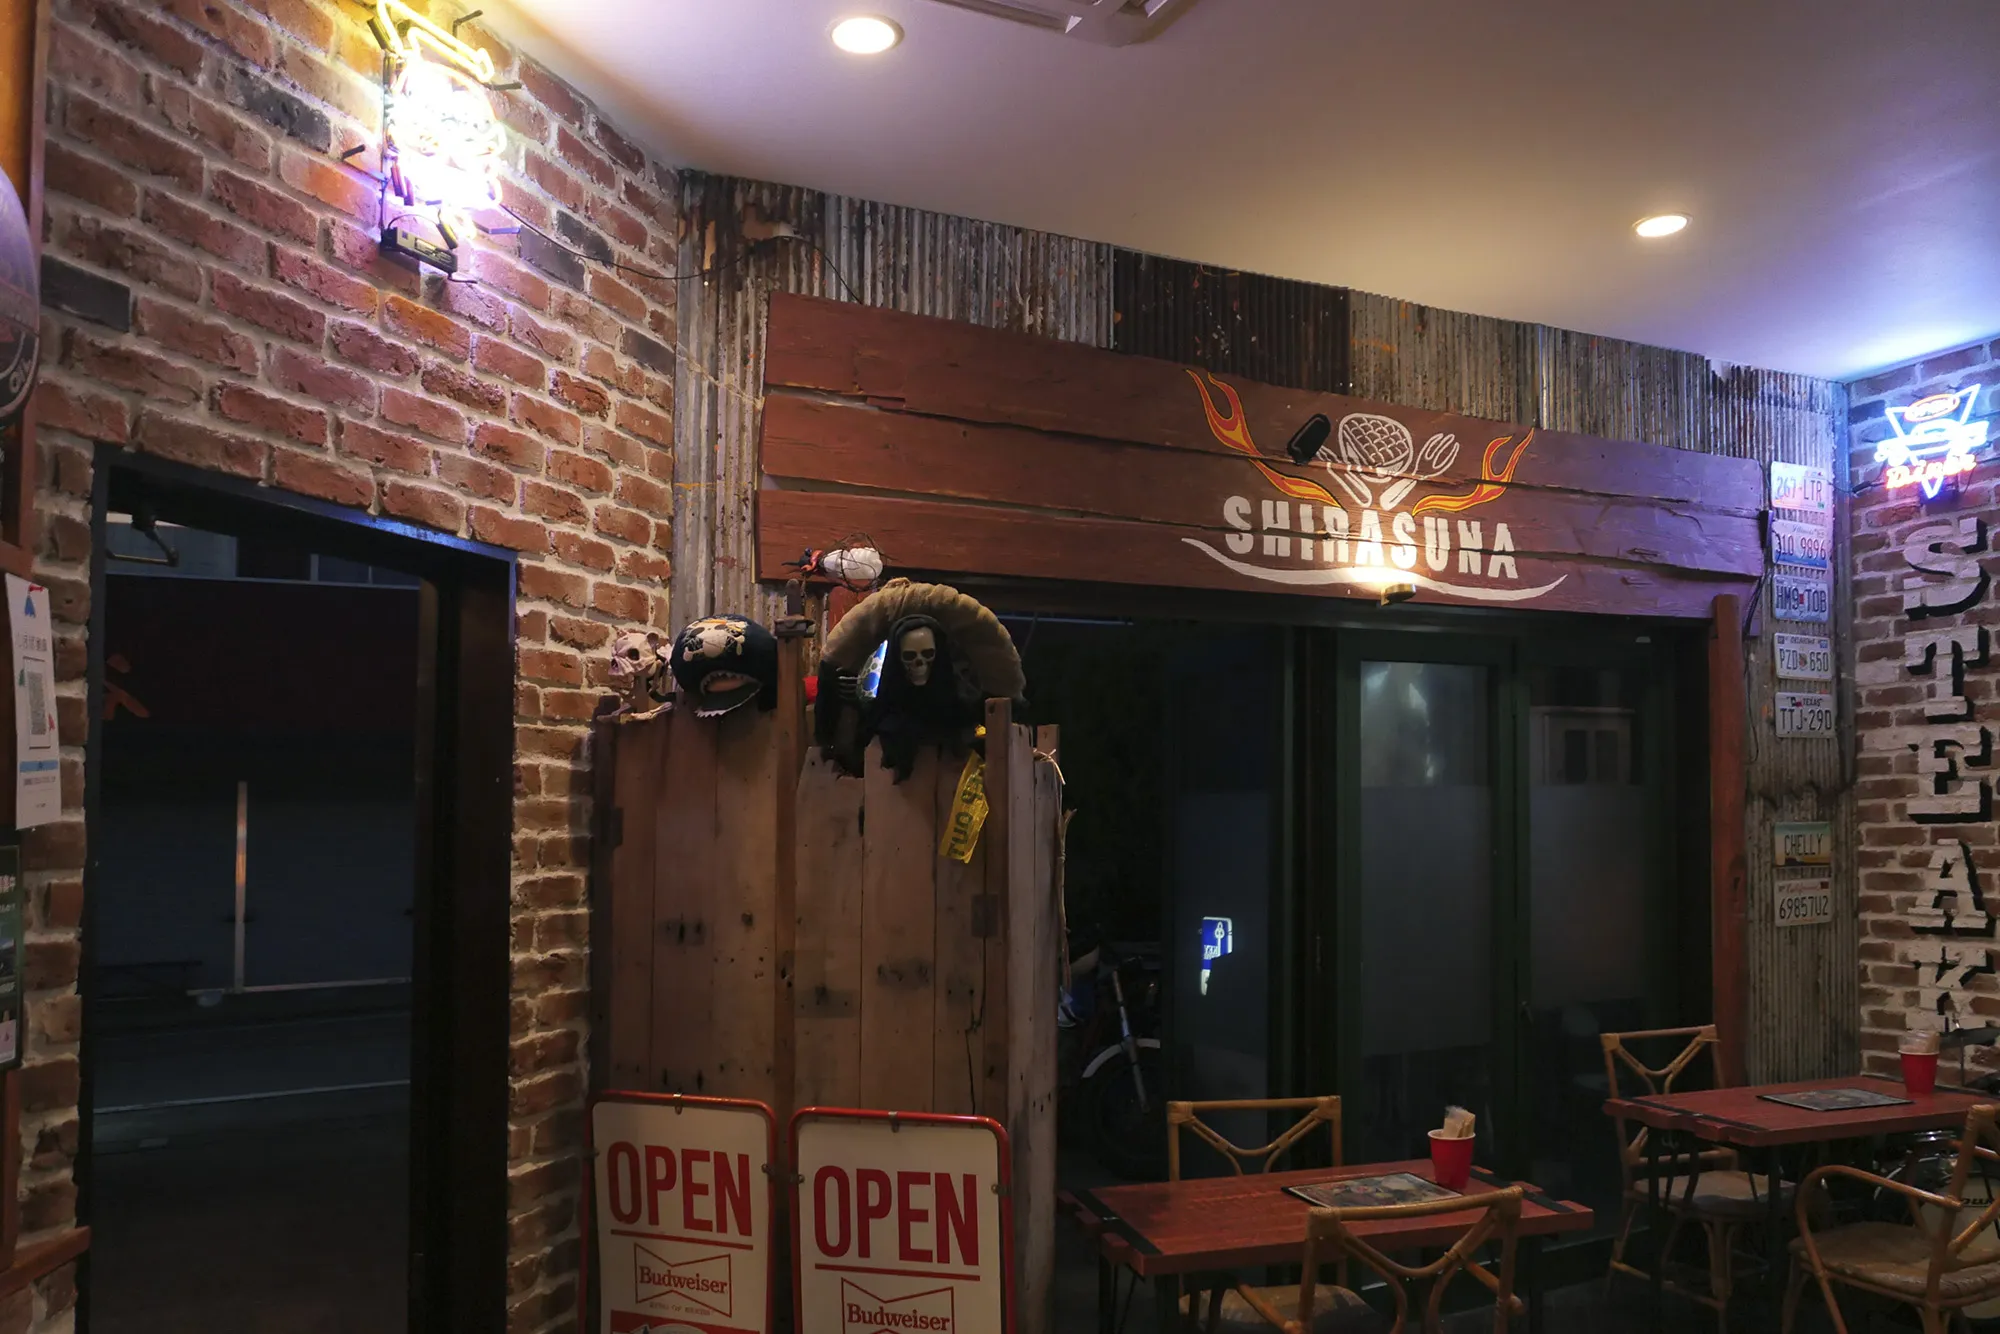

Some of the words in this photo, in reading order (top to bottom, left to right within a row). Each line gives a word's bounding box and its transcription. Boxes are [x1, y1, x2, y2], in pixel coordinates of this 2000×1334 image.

[1222, 495, 1519, 579] SHIRASUNA
[1800, 537, 1826, 561] 9896
[1775, 585, 1800, 610] HM9
[1779, 648, 1799, 671] PZD
[1809, 651, 1829, 672] 650
[1802, 697, 1822, 707] TEXAS
[1904, 516, 1992, 1034] STEAK
[1784, 833, 1824, 856] CHELLY
[1779, 895, 1829, 919] 69857U2
[607, 1140, 753, 1237] OPEN
[813, 1164, 980, 1266] OPEN
[639, 1265, 728, 1294] Budweiser
[846, 1303, 951, 1331] Budweiser
